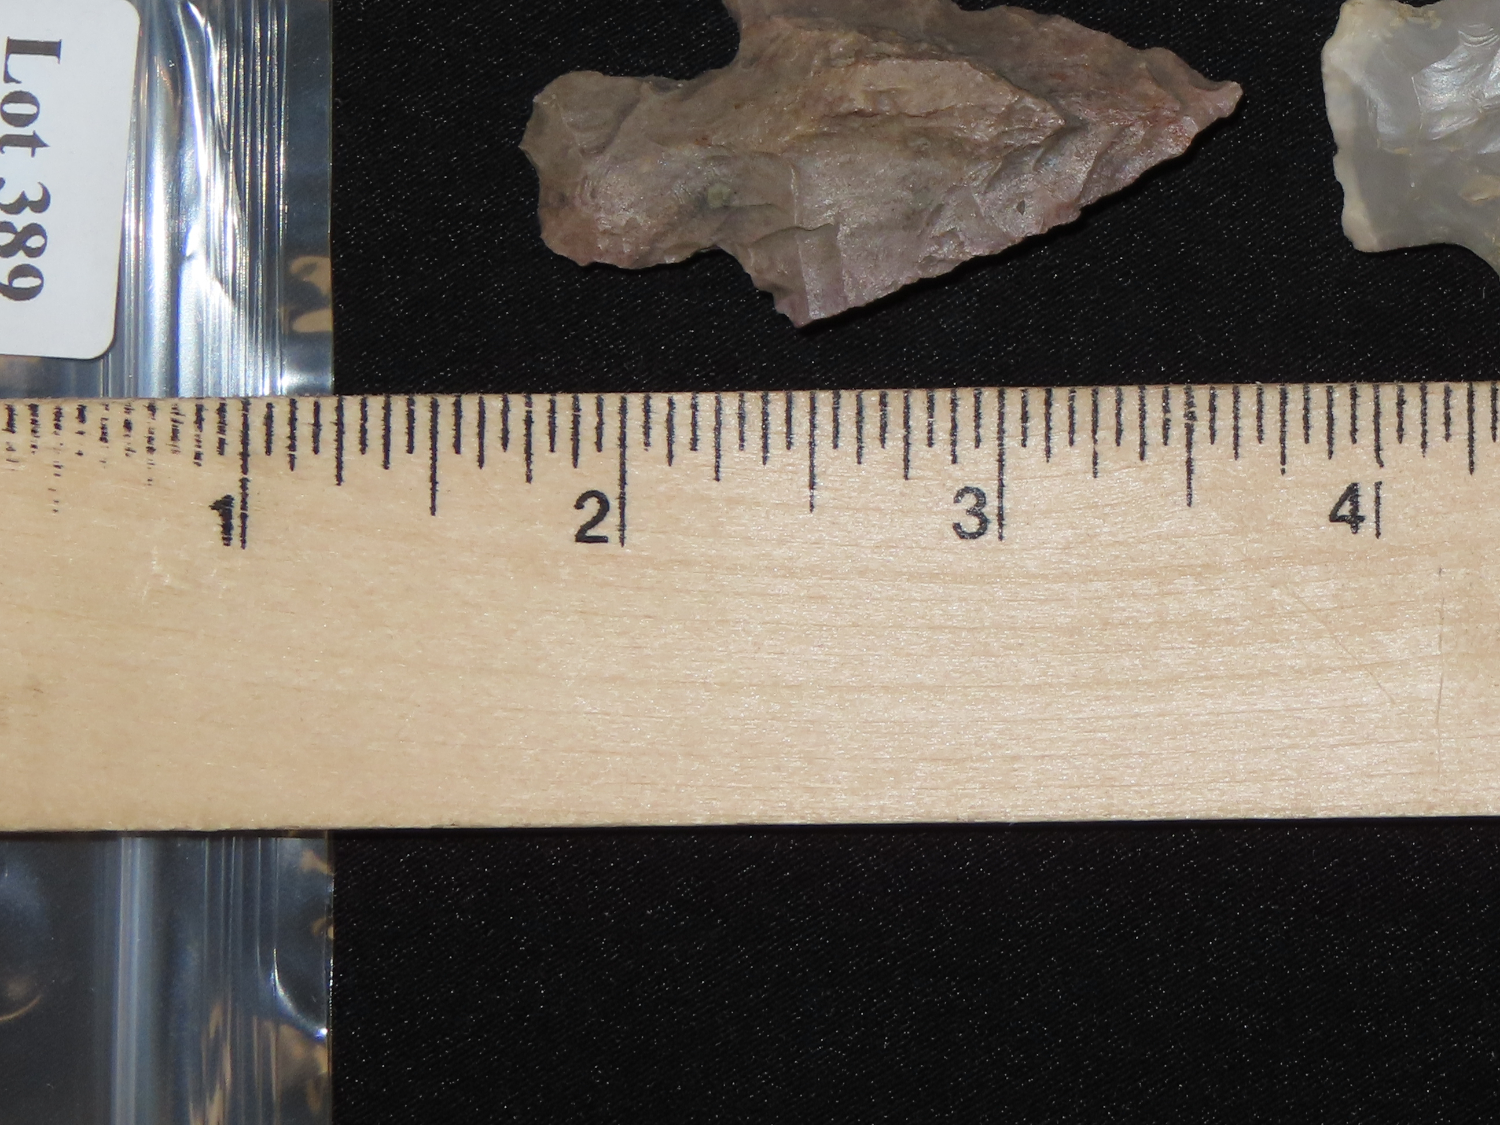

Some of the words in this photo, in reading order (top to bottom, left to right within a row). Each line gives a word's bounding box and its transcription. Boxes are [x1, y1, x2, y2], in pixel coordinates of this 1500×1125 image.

[0, 36, 62, 157] Lot
[0, 181, 51, 301] 389
[209, 494, 235, 547] 1
[574, 490, 609, 543] 2
[953, 487, 989, 539] 3
[1329, 483, 1365, 535] 4
